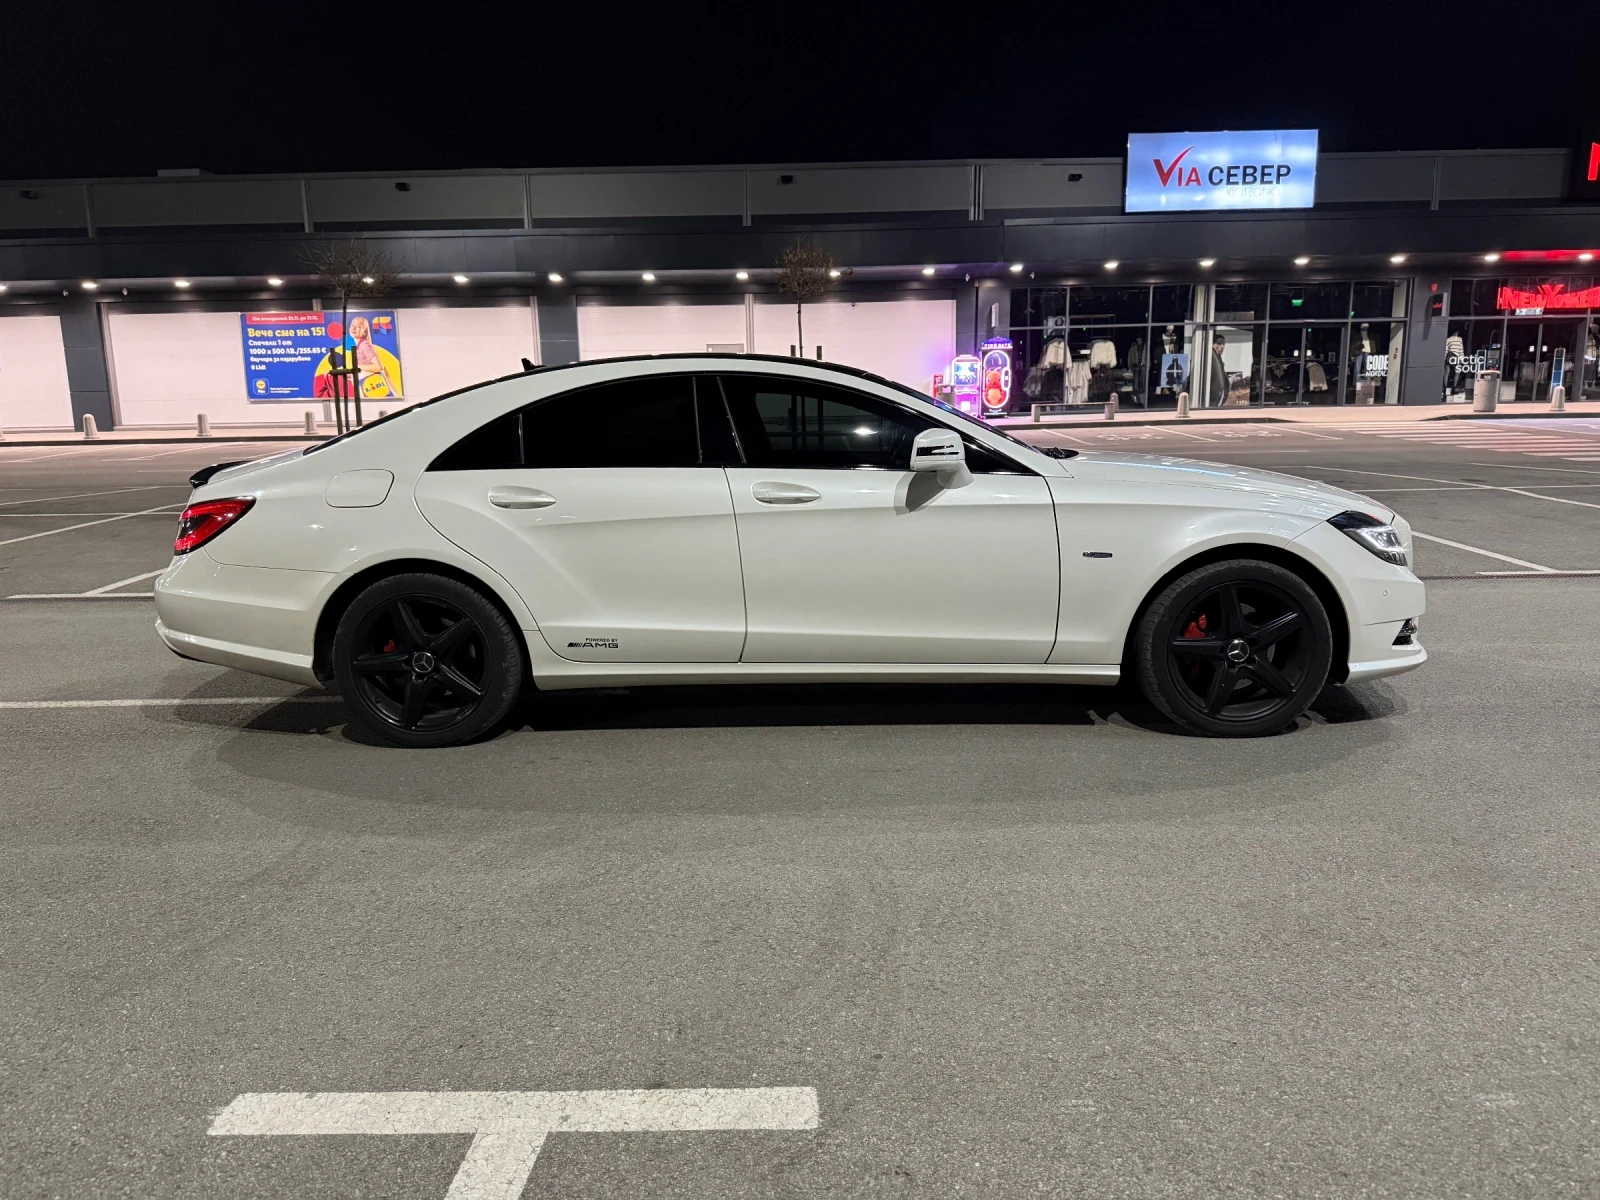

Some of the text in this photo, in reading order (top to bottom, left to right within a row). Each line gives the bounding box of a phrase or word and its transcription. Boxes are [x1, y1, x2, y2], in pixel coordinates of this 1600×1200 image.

[1153, 145, 1291, 188] VIA СЕВЕР
[247, 328, 273, 337] Вече
[275, 329, 295, 337] сме
[310, 327, 326, 336] 15!
[1366, 355, 1389, 370] CODE
[1448, 354, 1485, 365] arctic
